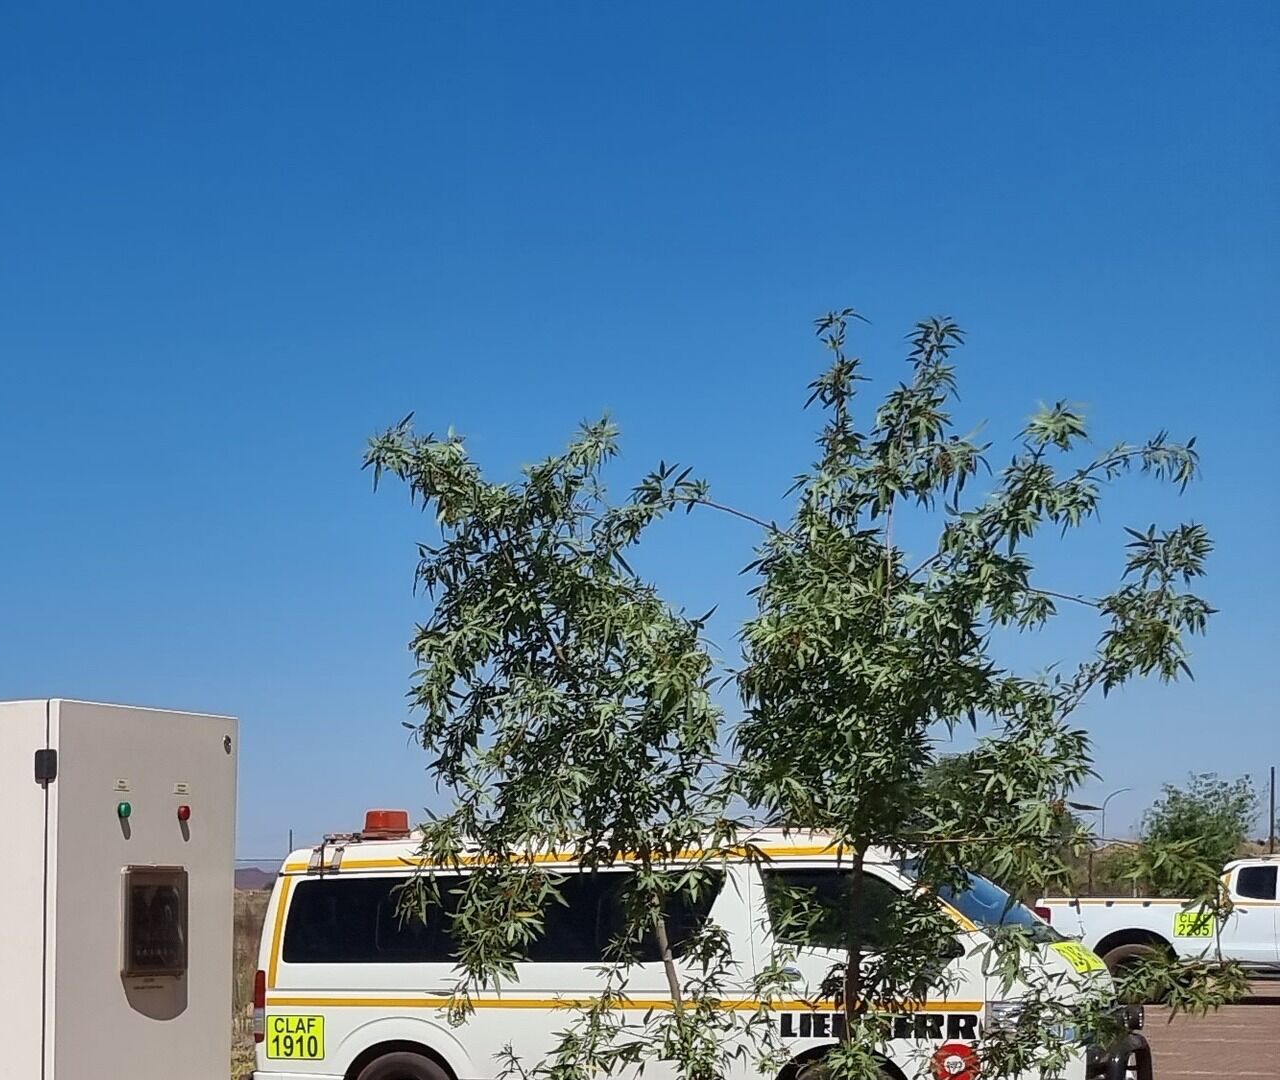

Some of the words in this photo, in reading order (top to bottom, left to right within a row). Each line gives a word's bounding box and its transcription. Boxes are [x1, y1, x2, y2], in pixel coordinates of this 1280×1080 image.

[274, 1017, 316, 1034] CLAF
[780, 1012, 980, 1040] LIEERR
[272, 1035, 318, 1057] 1910
